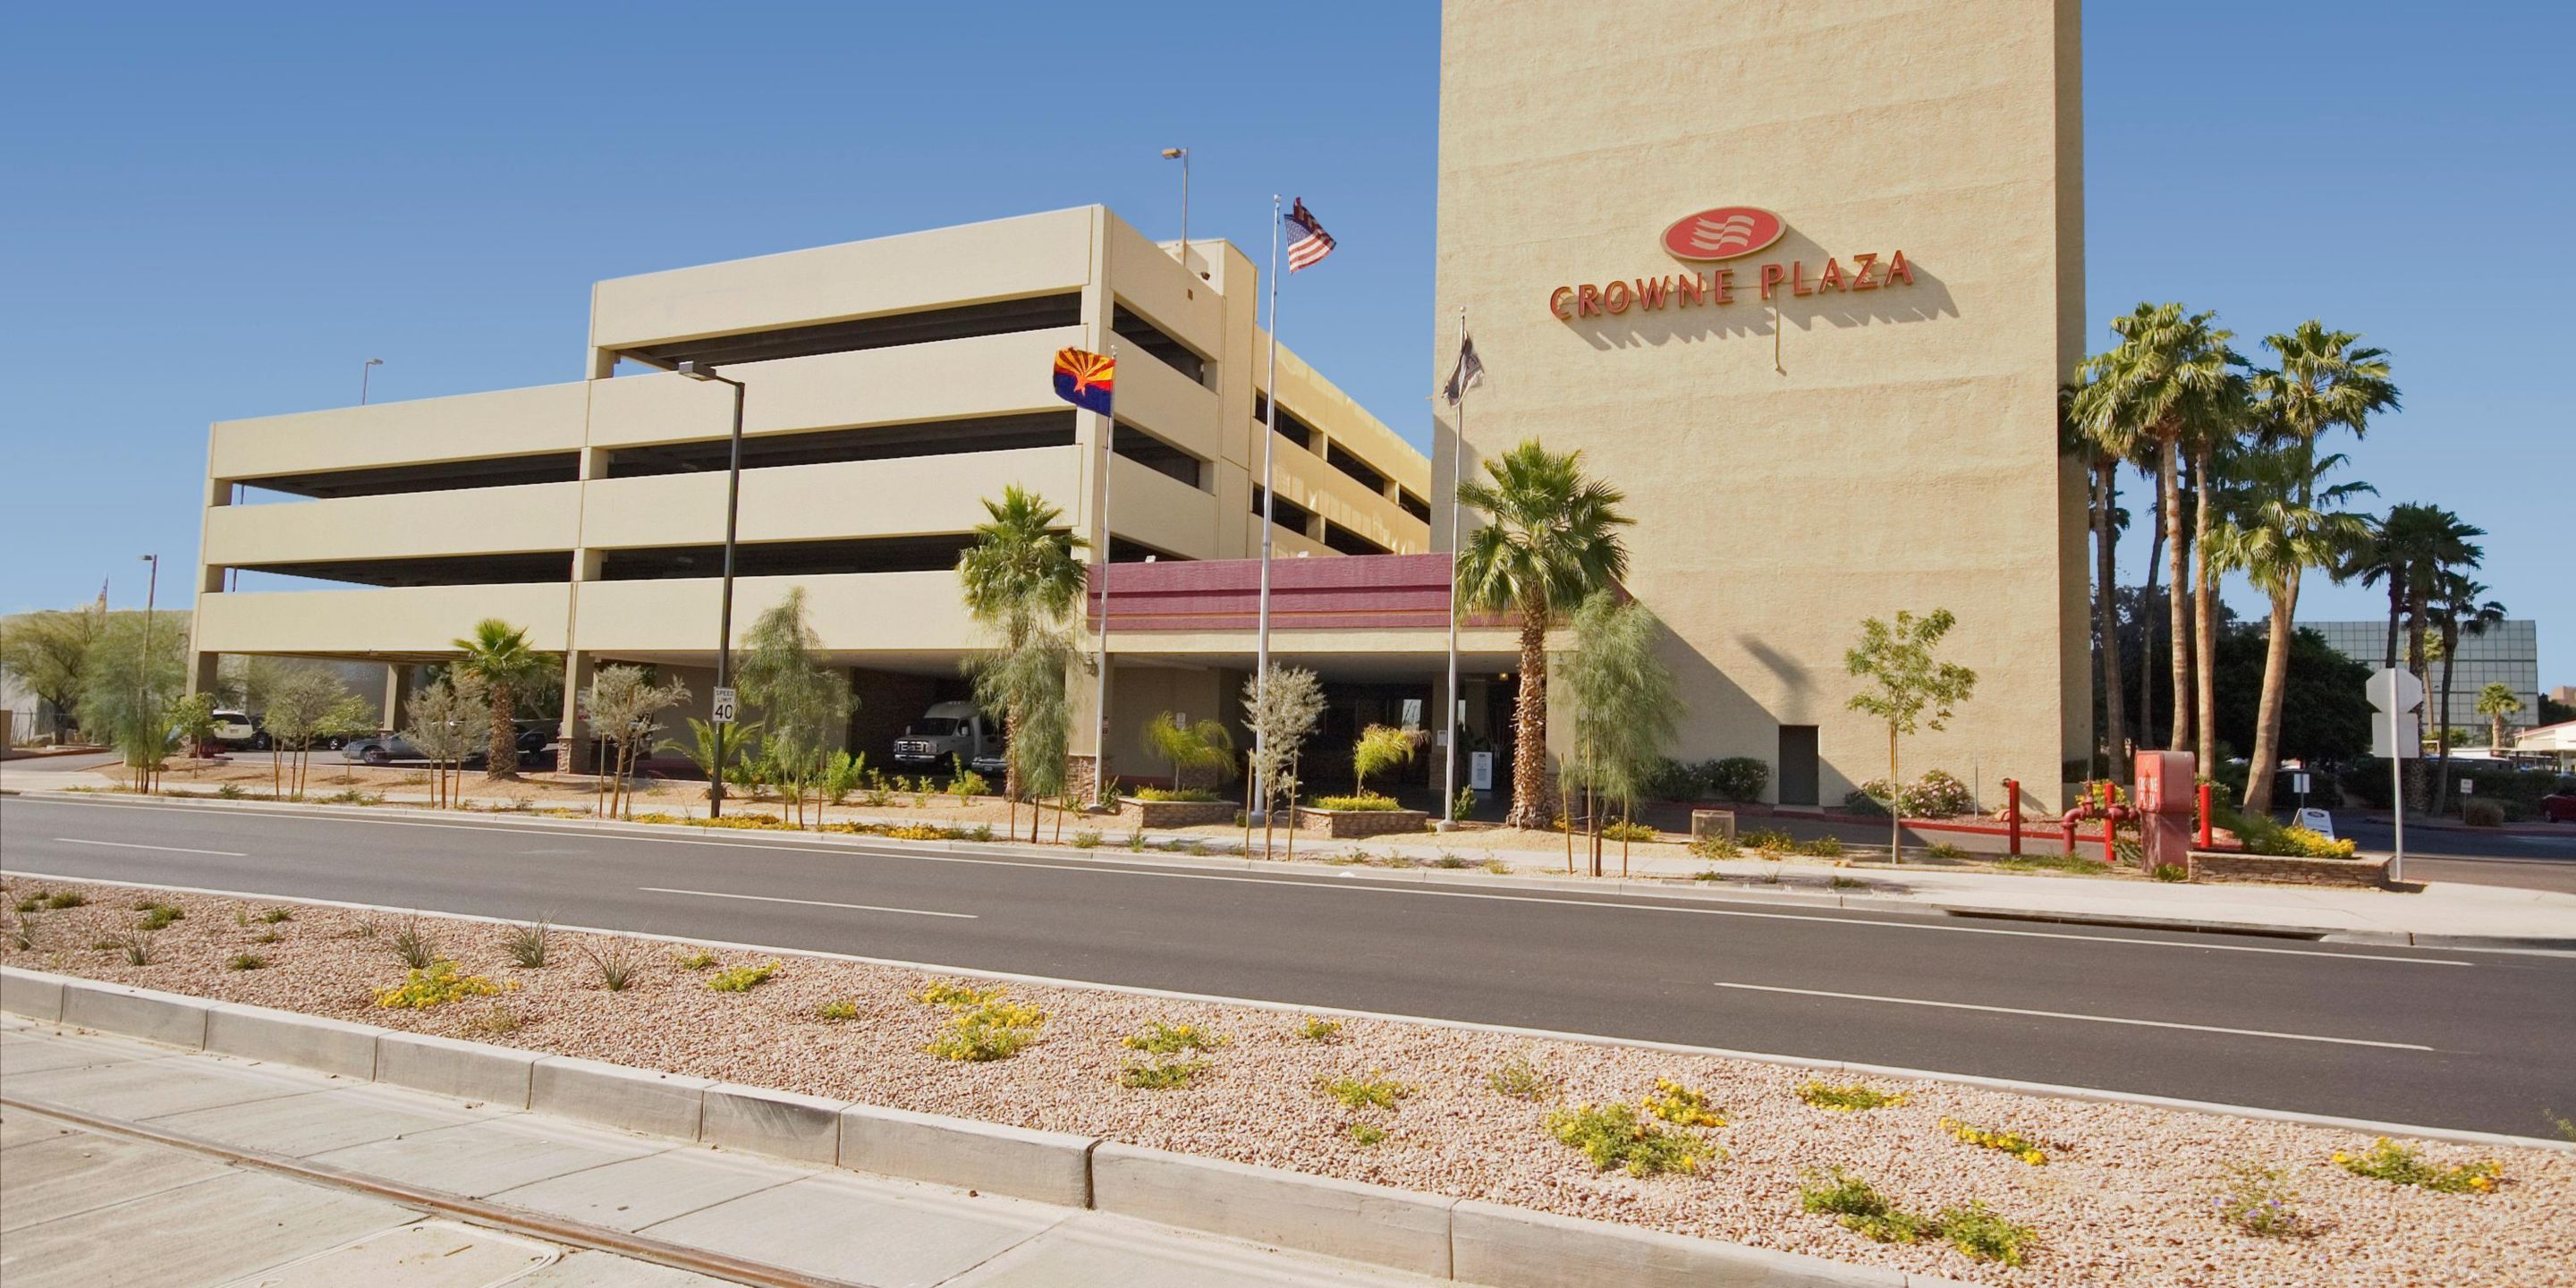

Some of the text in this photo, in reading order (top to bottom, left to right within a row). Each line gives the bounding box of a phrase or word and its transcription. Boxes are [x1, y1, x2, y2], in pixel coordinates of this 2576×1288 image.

[1550, 250, 1914, 320] CROWNE PLAZA
[715, 704, 733, 719] 40
